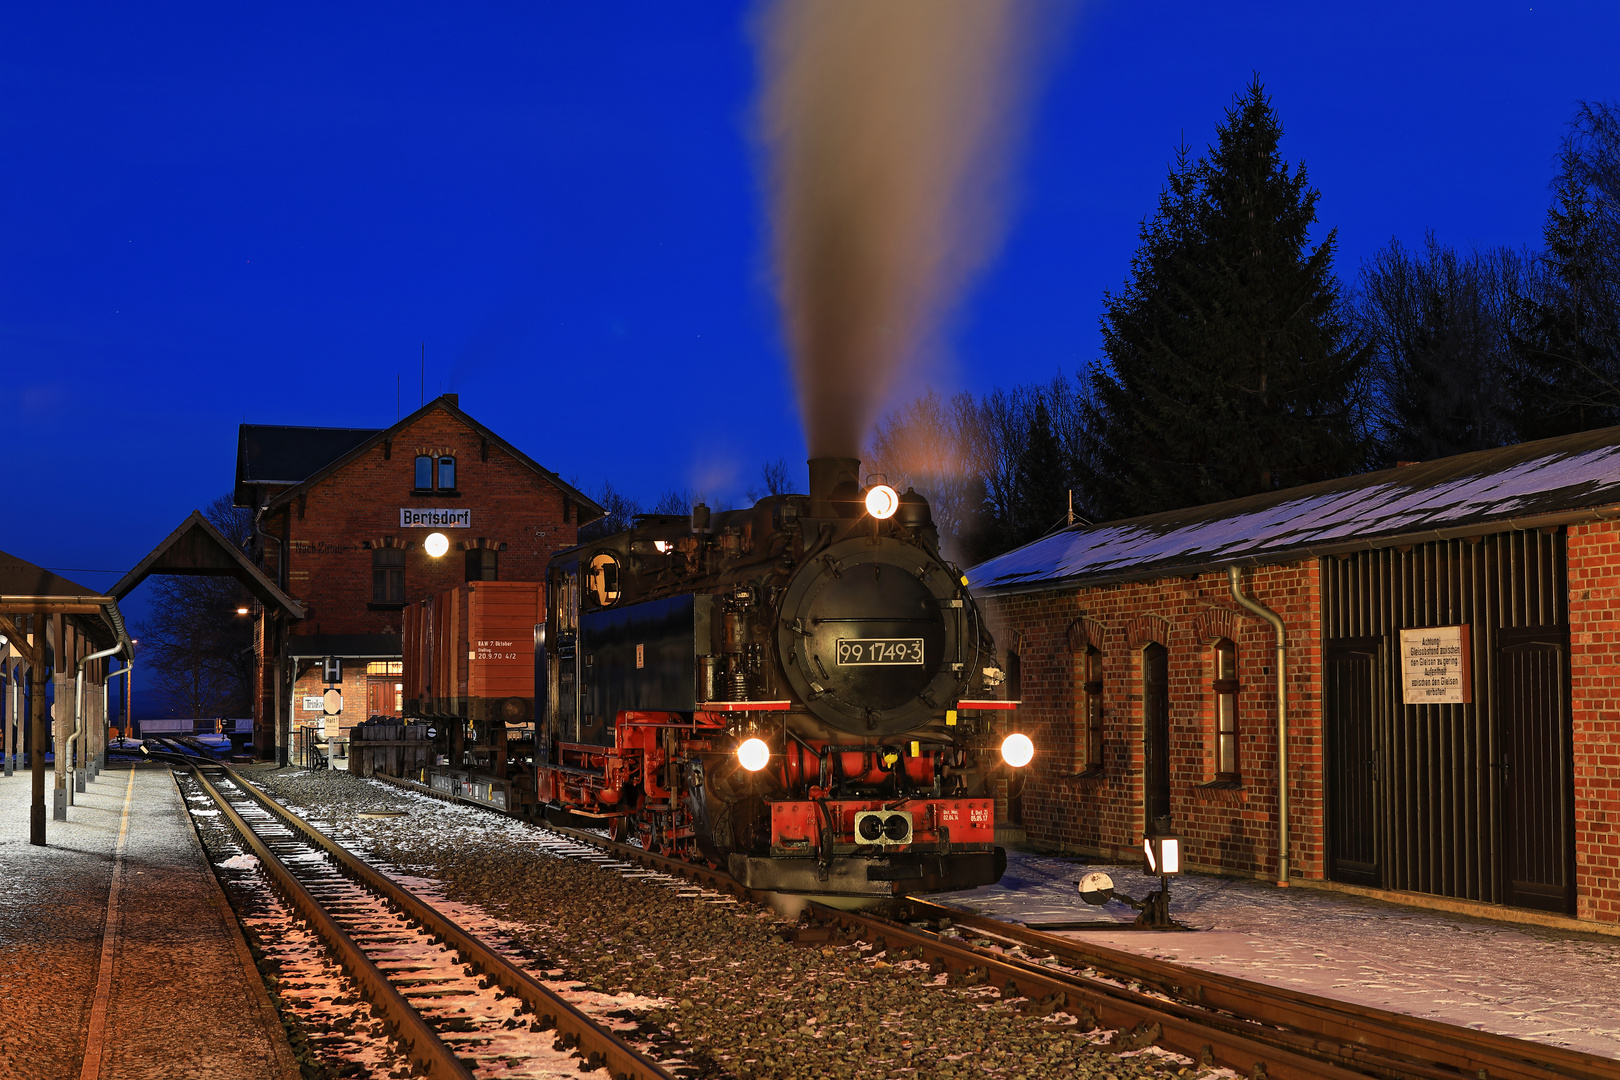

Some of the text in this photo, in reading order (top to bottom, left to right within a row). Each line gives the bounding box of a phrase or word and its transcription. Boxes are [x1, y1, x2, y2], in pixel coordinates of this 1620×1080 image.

[404, 510, 468, 524] Bertsdorf
[296, 542, 342, 554] Nach Zittau
[1422, 637, 1440, 647] Achtung!
[840, 643, 921, 661] 99 1749-3
[1411, 645, 1459, 656] Gleisabstand zwischen
[1420, 658, 1436, 666] Gleisen
[325, 660, 340, 680] H
[1425, 668, 1446, 676] Aufenthalt
[1412, 678, 1430, 686] zwischen
[1441, 677, 1458, 685] Gleisen
